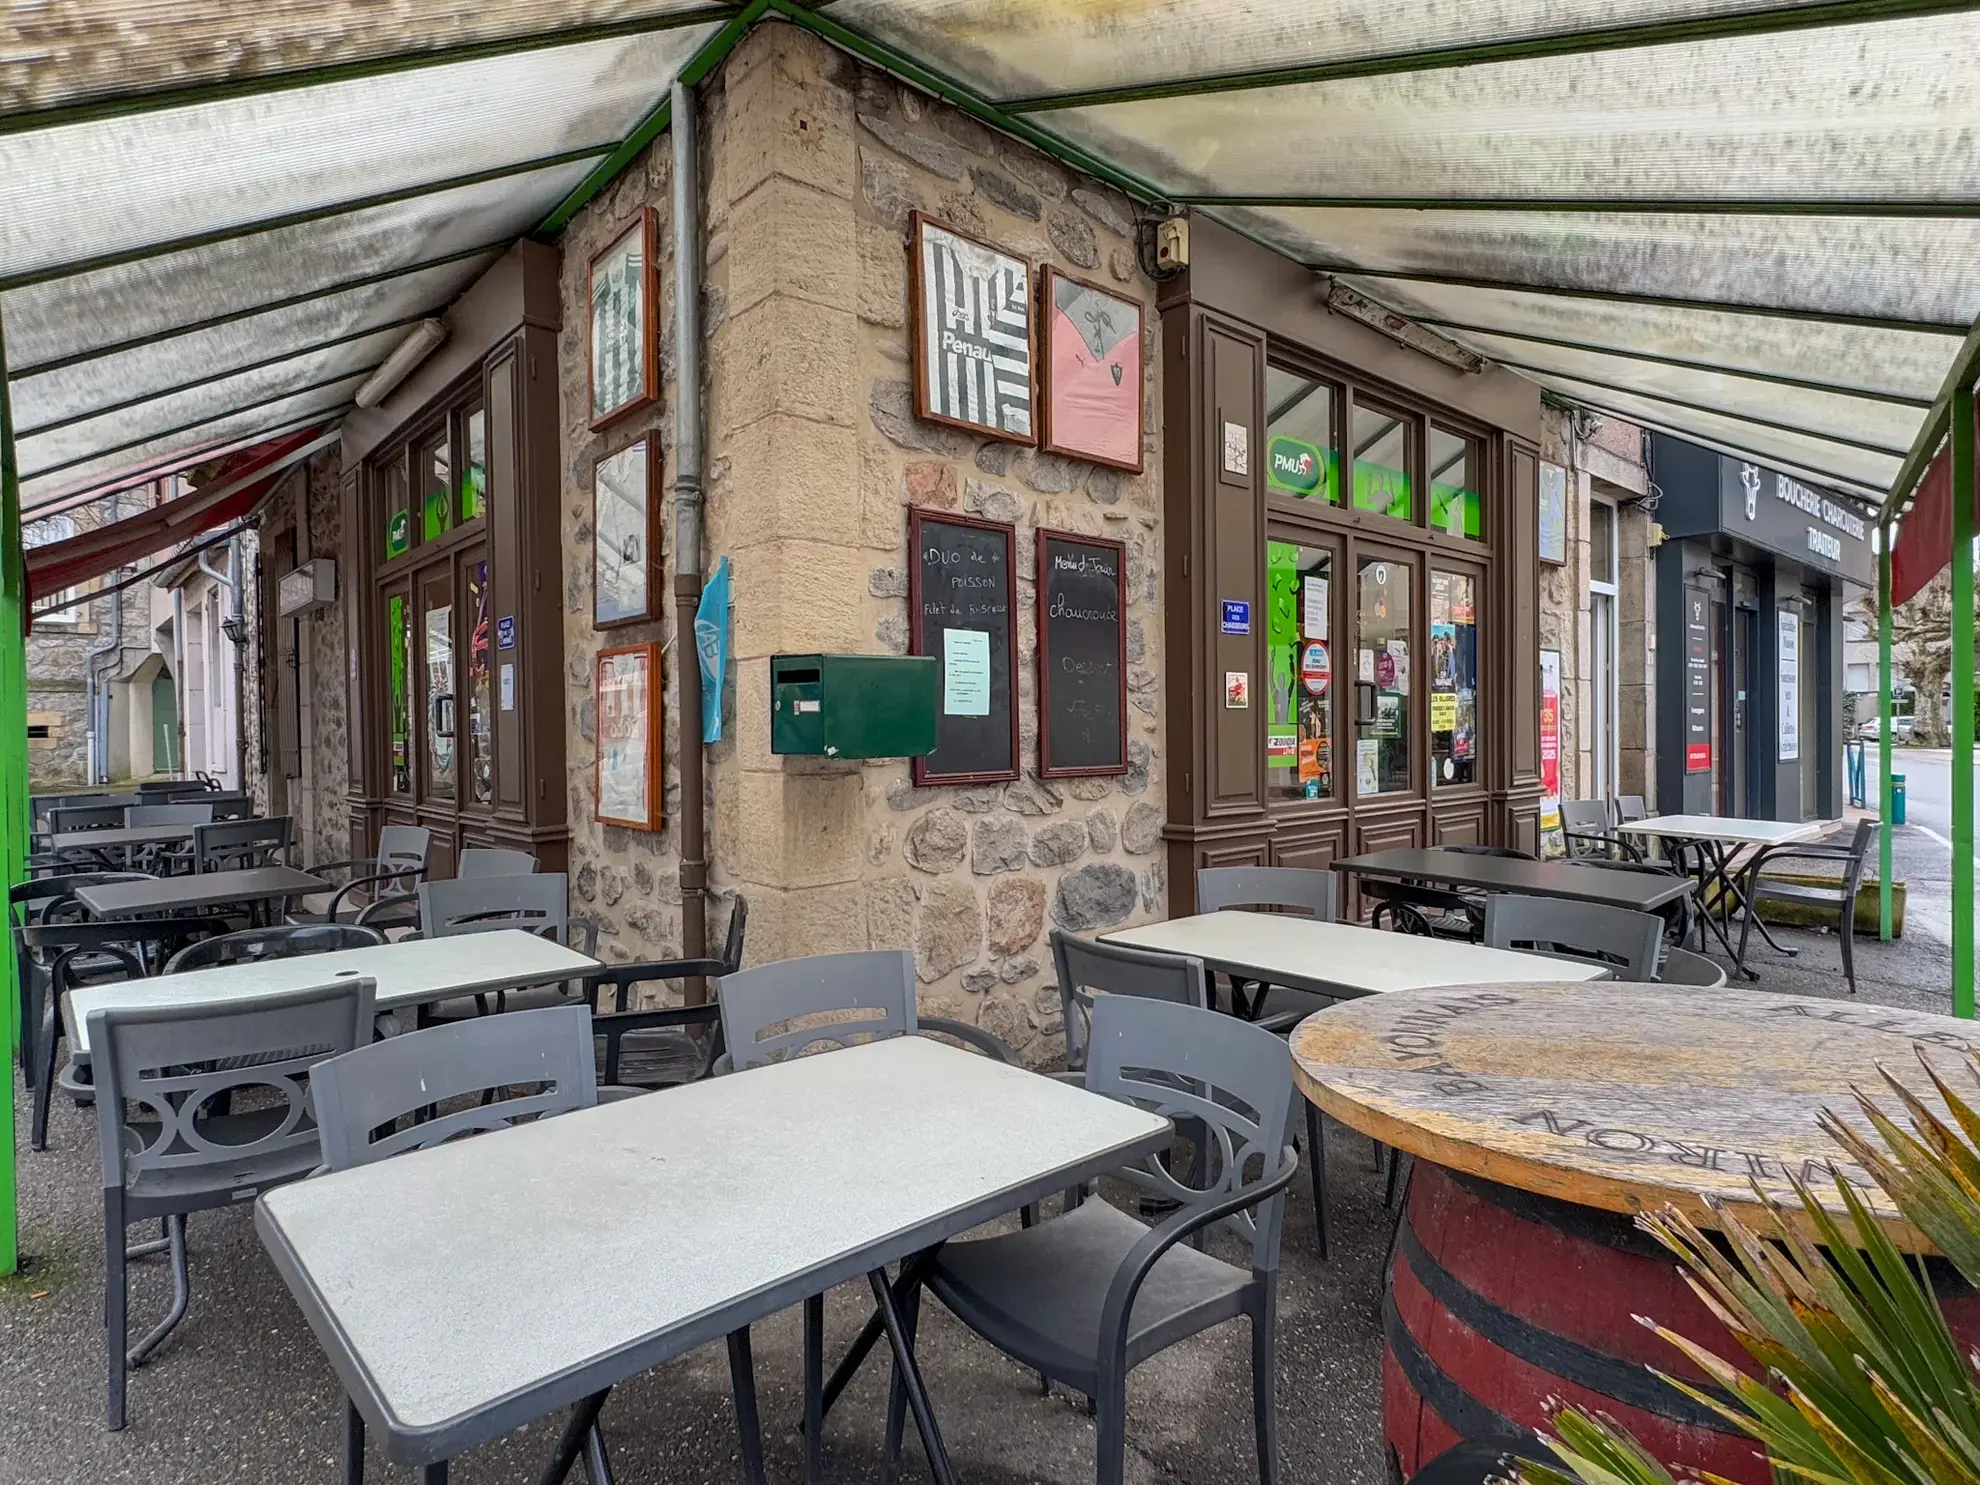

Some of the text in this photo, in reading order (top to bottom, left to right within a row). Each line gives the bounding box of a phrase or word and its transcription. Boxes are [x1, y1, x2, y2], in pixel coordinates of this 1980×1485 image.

[1274, 453, 1300, 474] PMU
[1776, 473, 1865, 541] BOUCHERIE CHARCUTERIE
[927, 548, 986, 566] DUO de
[1806, 526, 1840, 562] TRAITEUR
[1227, 605, 1244, 613] PLACE
[1758, 1004, 1971, 1053] ALLE
[1507, 1109, 1880, 1189] VIRON
